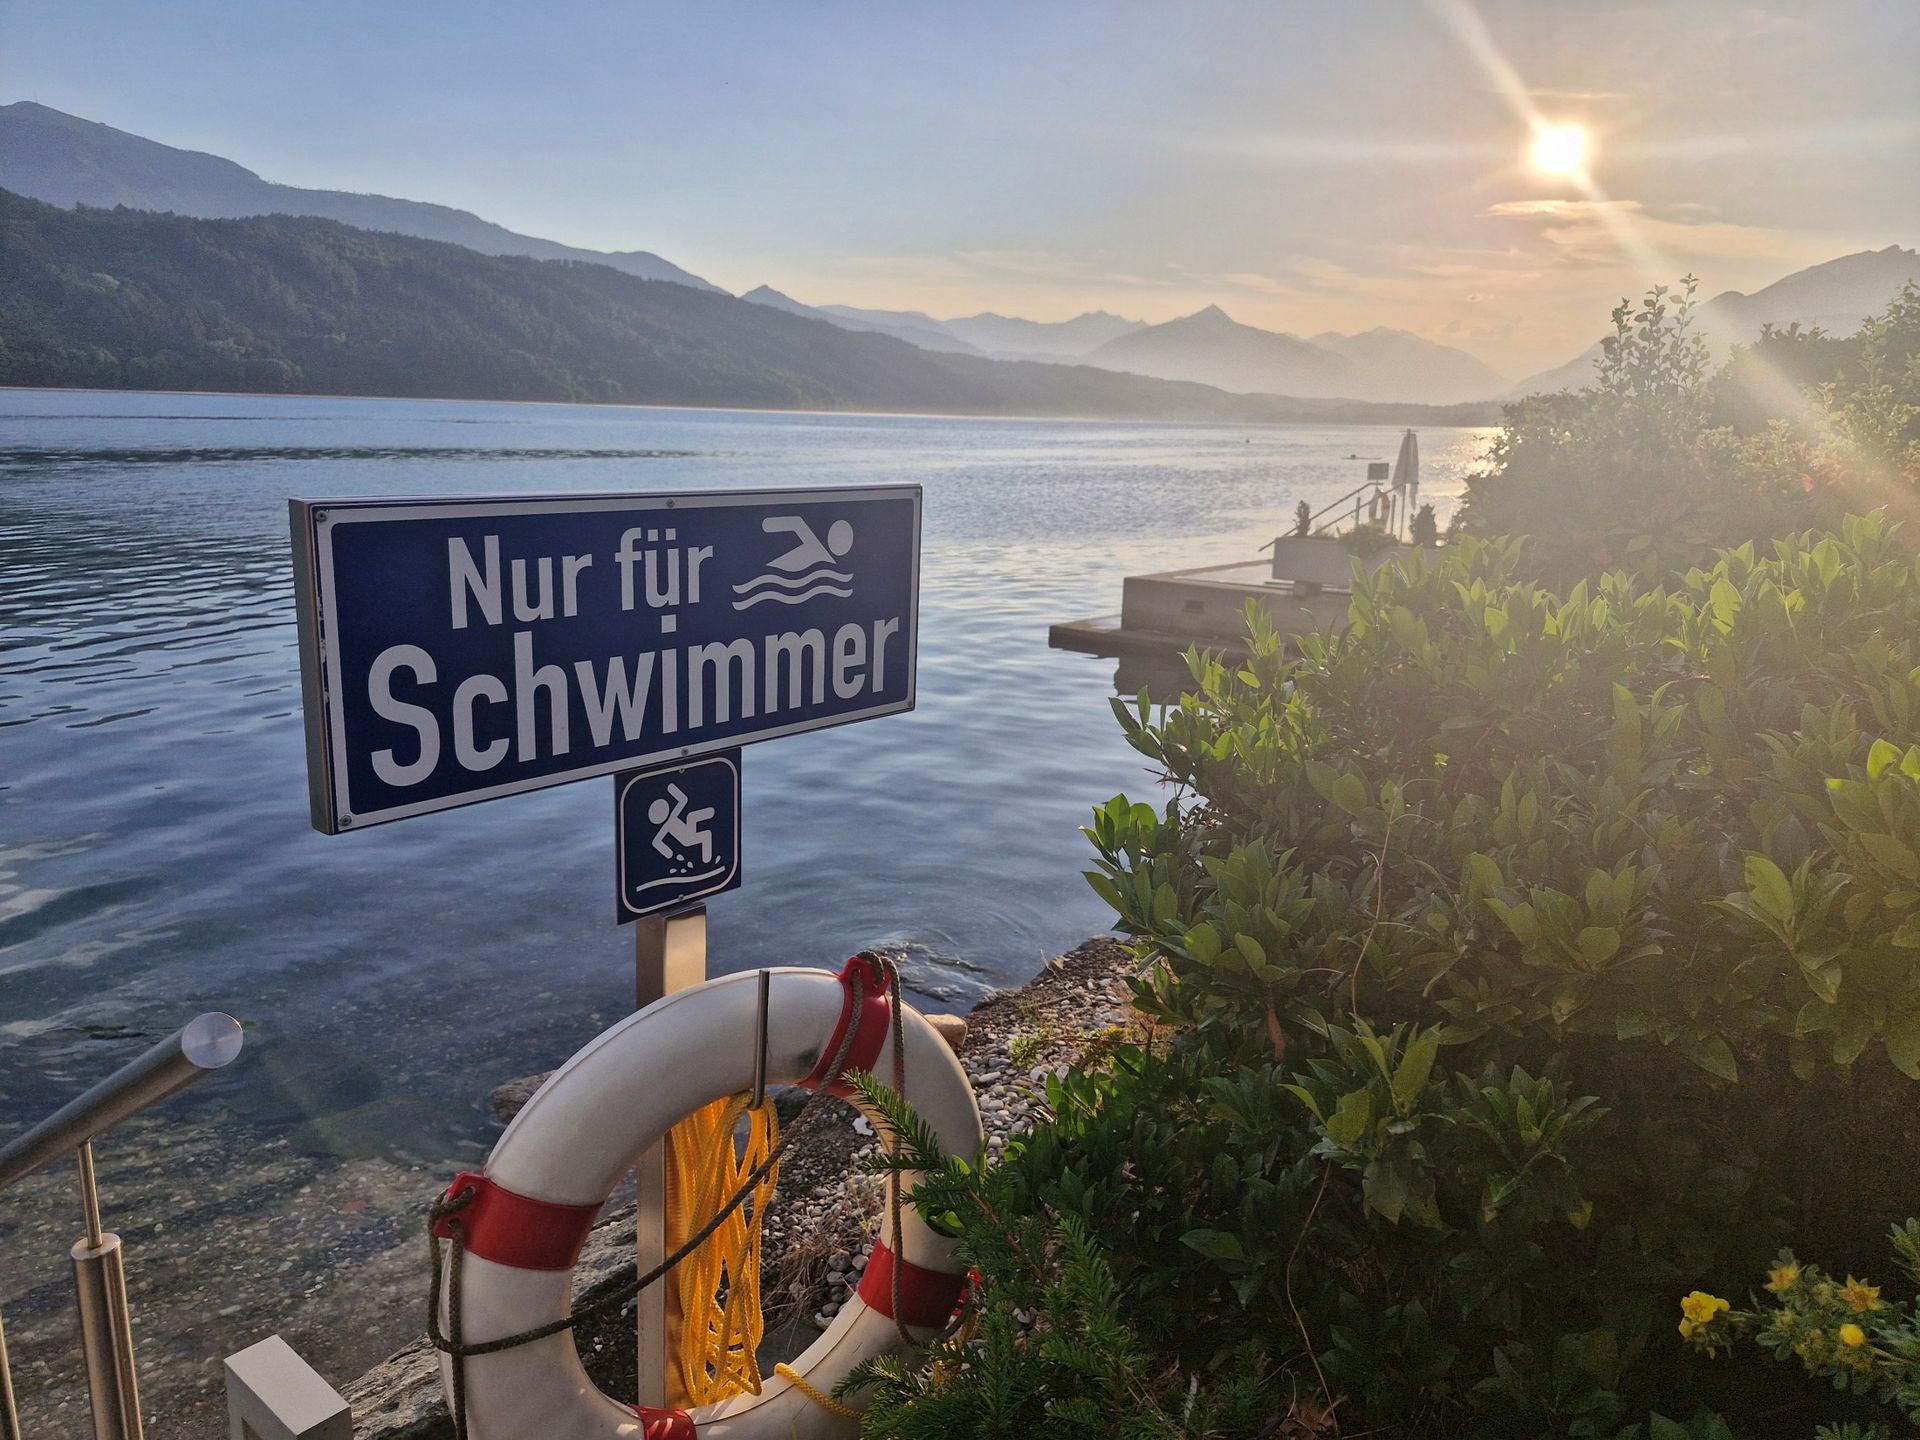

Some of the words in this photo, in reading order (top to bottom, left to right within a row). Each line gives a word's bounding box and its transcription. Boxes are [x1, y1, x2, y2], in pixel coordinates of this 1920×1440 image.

[447, 534, 593, 630] Nur
[614, 527, 714, 611] für
[367, 614, 900, 787] Schwimmer
